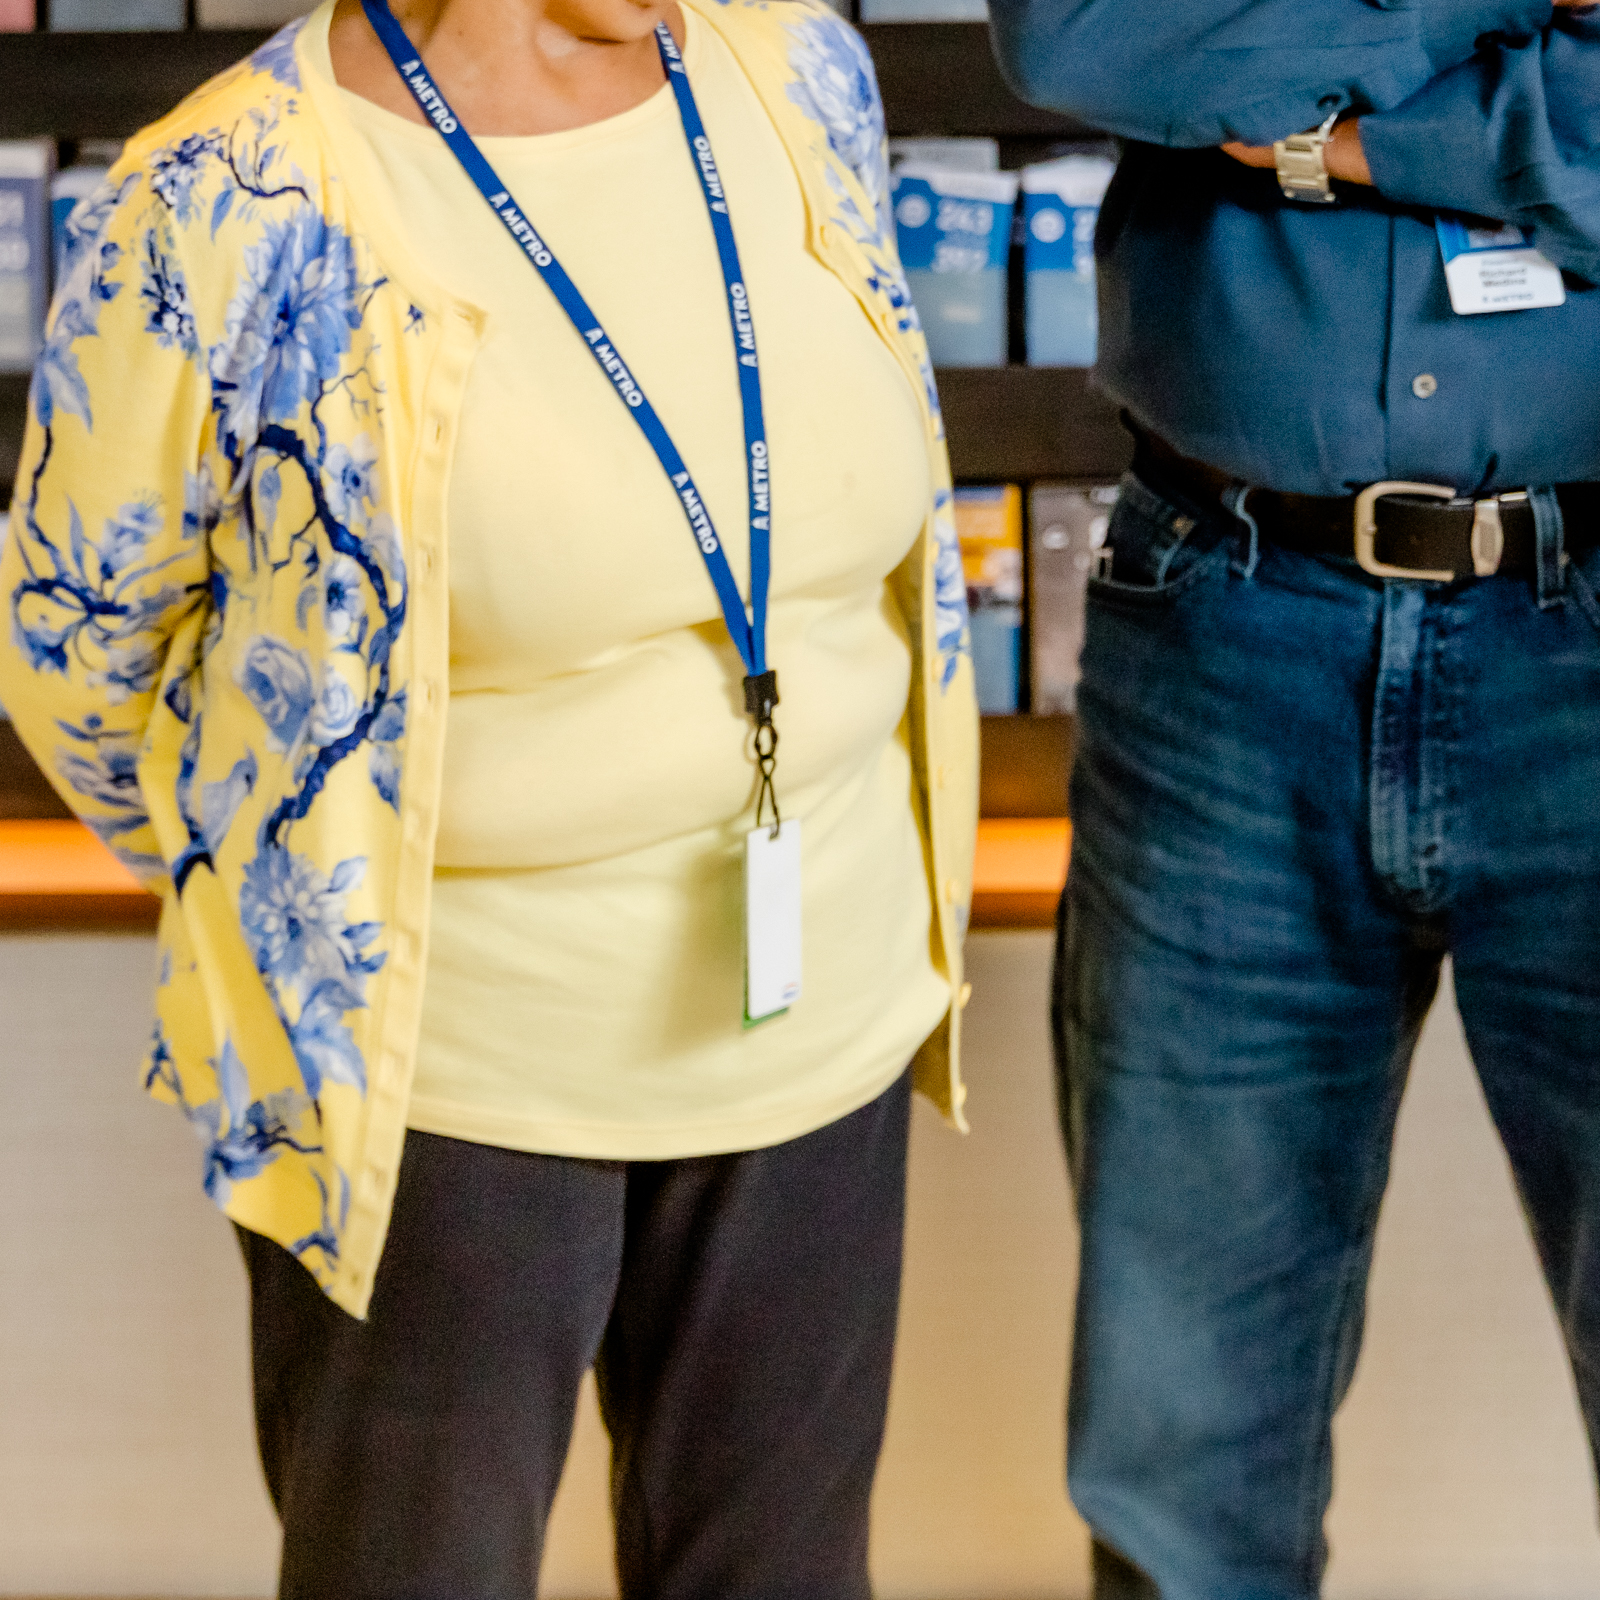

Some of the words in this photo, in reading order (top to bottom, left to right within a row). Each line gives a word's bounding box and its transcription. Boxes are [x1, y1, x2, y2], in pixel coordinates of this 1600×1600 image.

[411, 72, 457, 134] METRO
[694, 136, 726, 199] METRO
[501, 207, 552, 267] METRO
[731, 283, 756, 352] METRO
[595, 344, 644, 408] METRO
[752, 440, 768, 510] METRO
[682, 487, 718, 555] METRO
